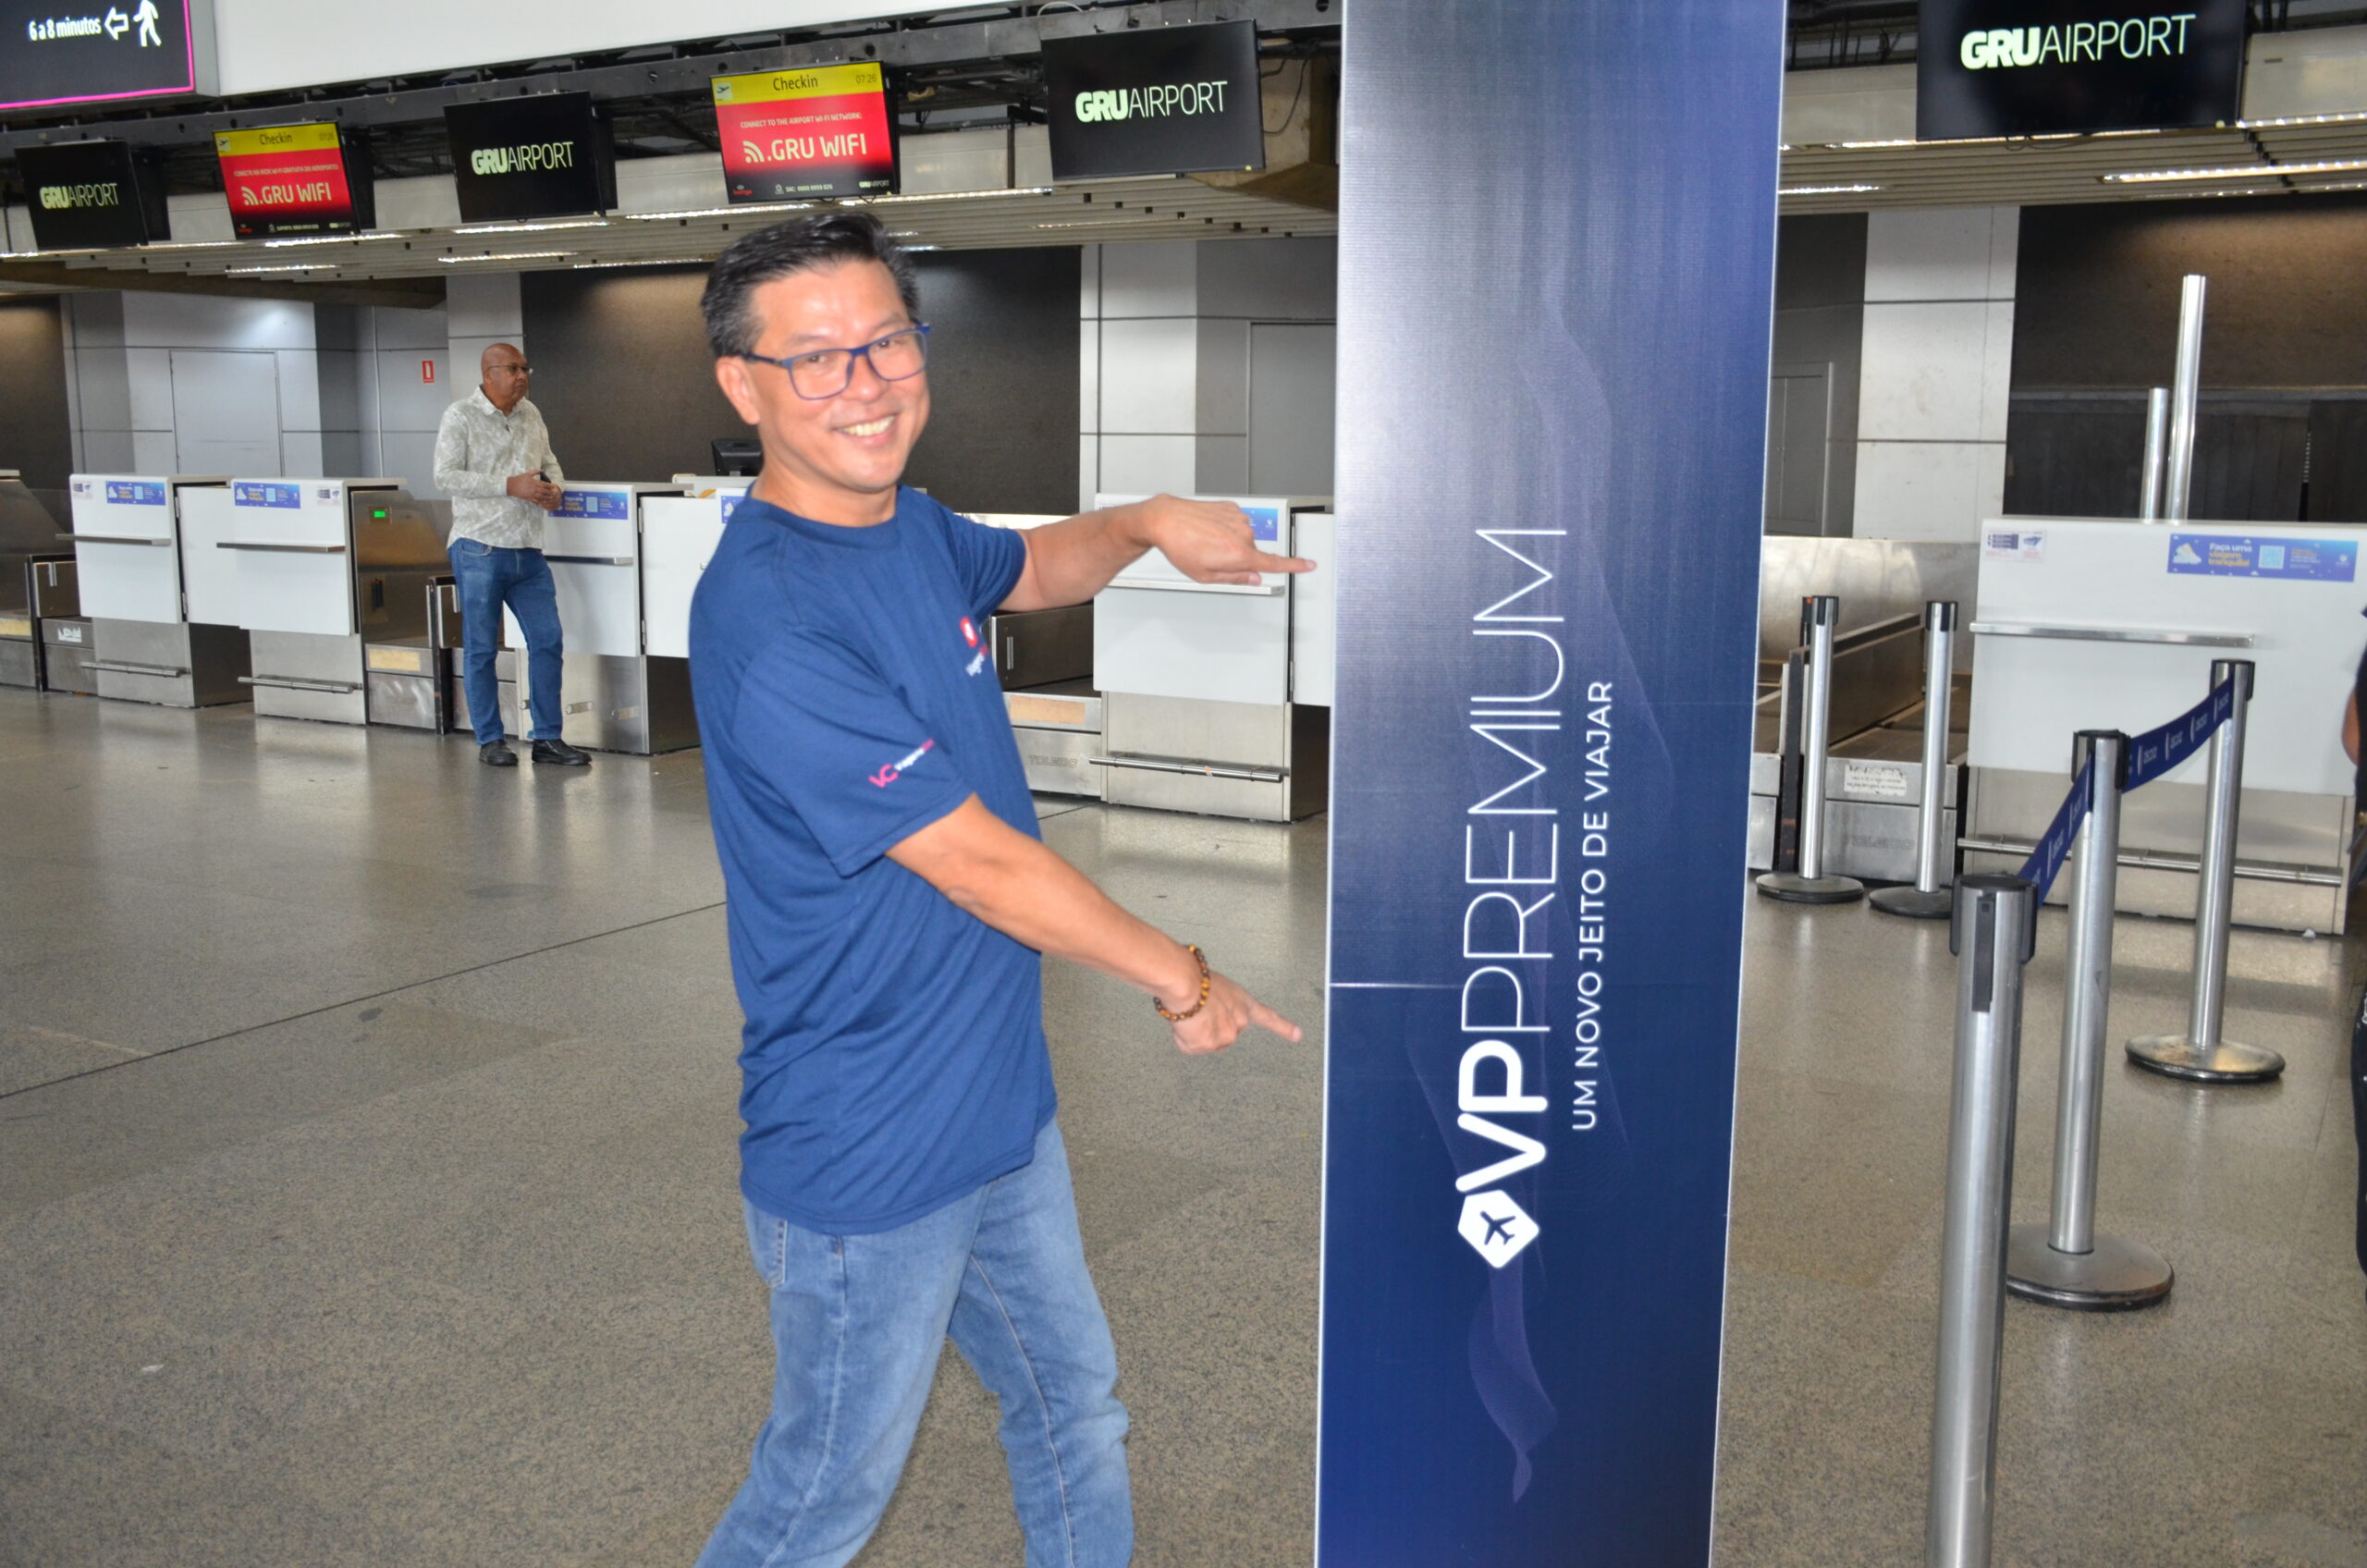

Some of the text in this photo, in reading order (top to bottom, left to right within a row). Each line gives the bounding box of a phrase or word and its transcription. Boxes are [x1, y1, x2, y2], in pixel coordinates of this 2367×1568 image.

[29, 16, 102, 42] 6 a 8 minutos
[772, 75, 818, 91] Checkin
[740, 120, 767, 129] CONNECT
[777, 117, 788, 126] THE
[789, 116, 814, 125] AIRPORT
[259, 131, 293, 146] Checkin
[818, 132, 867, 158] WIFI
[296, 182, 331, 202] WIFI
[1572, 681, 1613, 1131] UM NOVO JEITO DE VIAJAR
